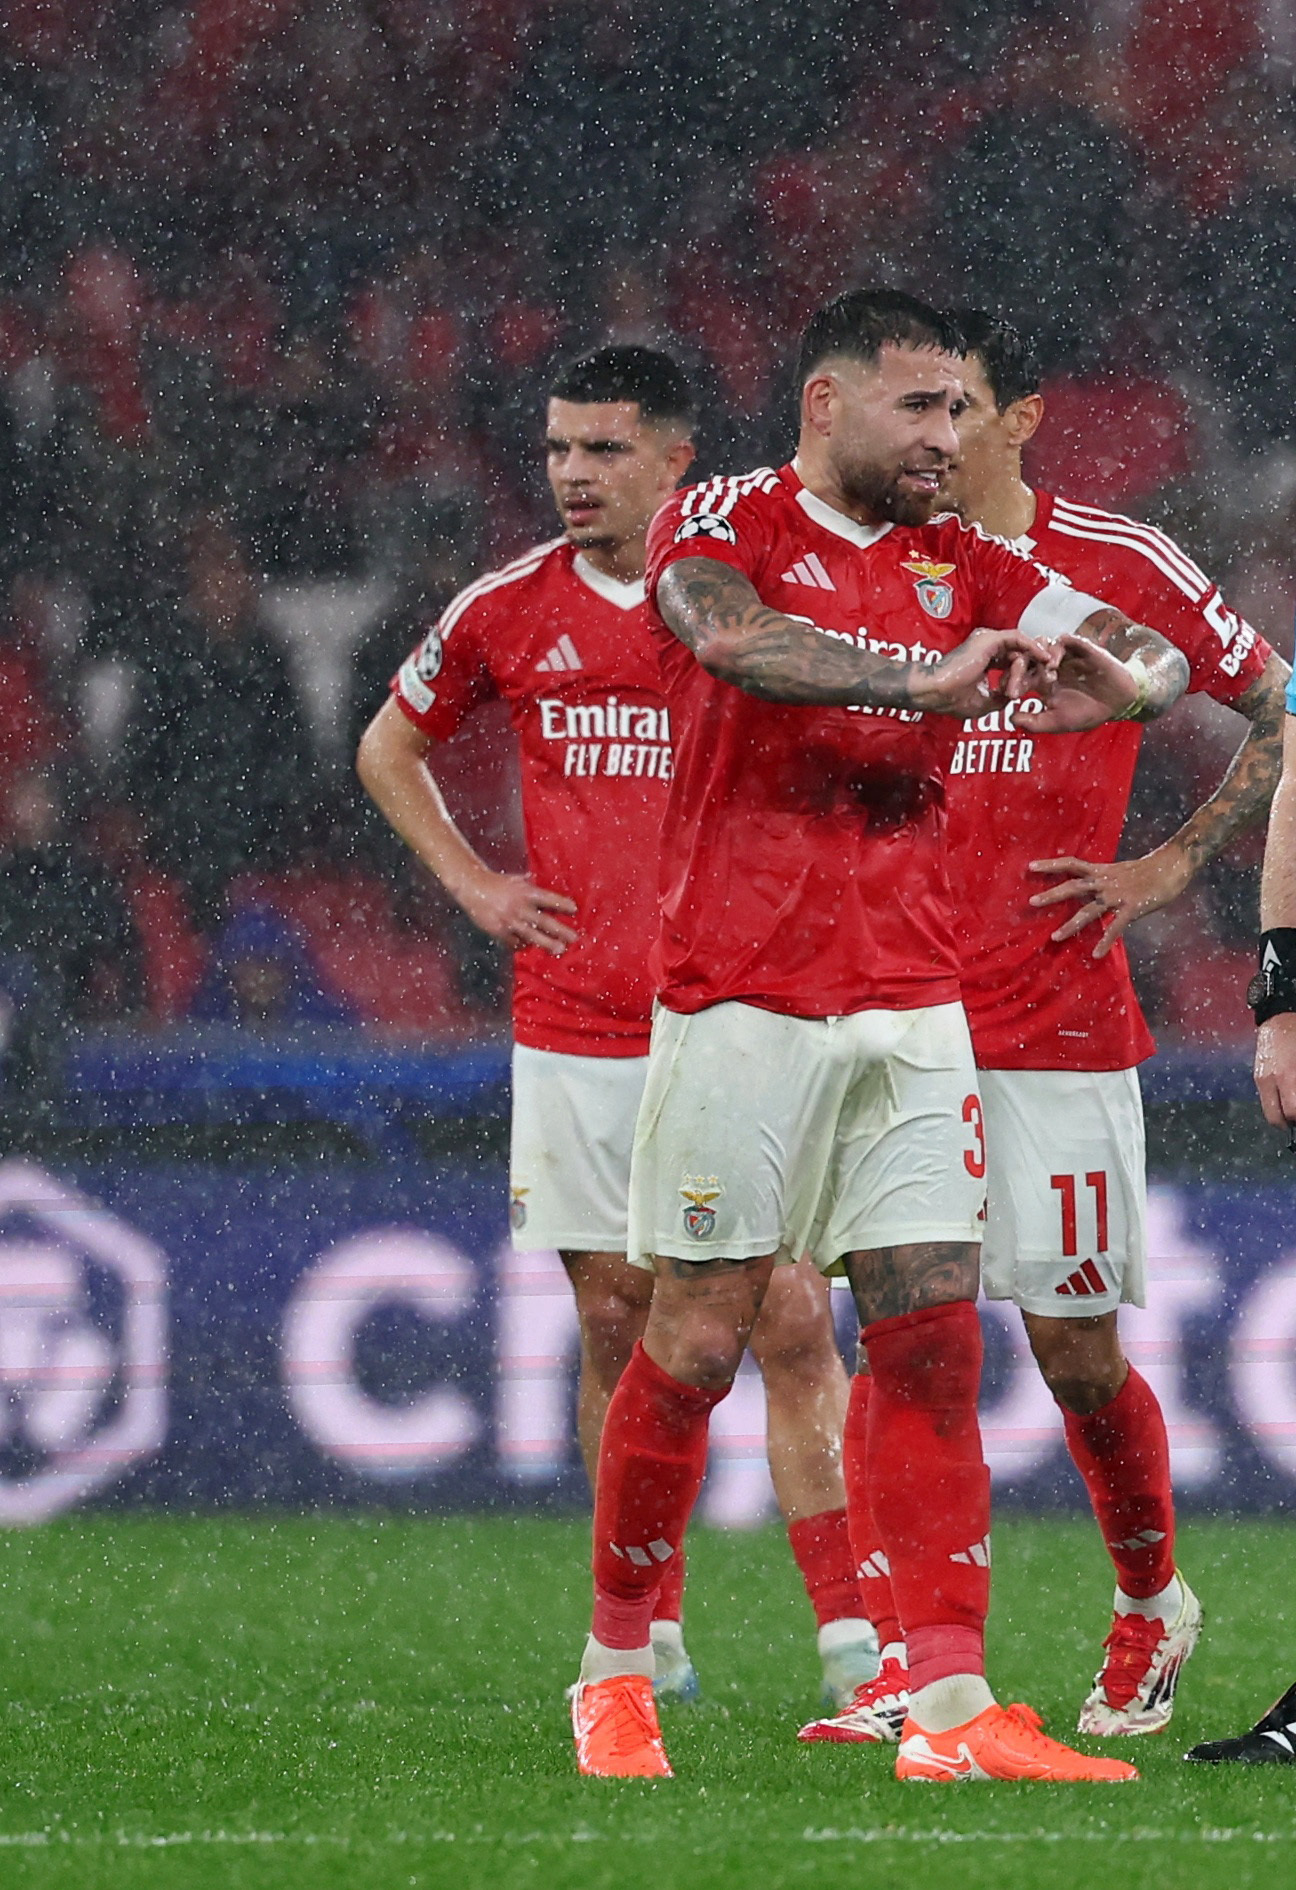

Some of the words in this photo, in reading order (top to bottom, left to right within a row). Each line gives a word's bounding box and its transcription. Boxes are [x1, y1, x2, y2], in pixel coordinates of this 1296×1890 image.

[564, 743, 602, 777] FLY
[604, 743, 675, 780] BETTE
[949, 739, 1033, 774] BETTER
[1050, 1170, 1108, 1256] 11
